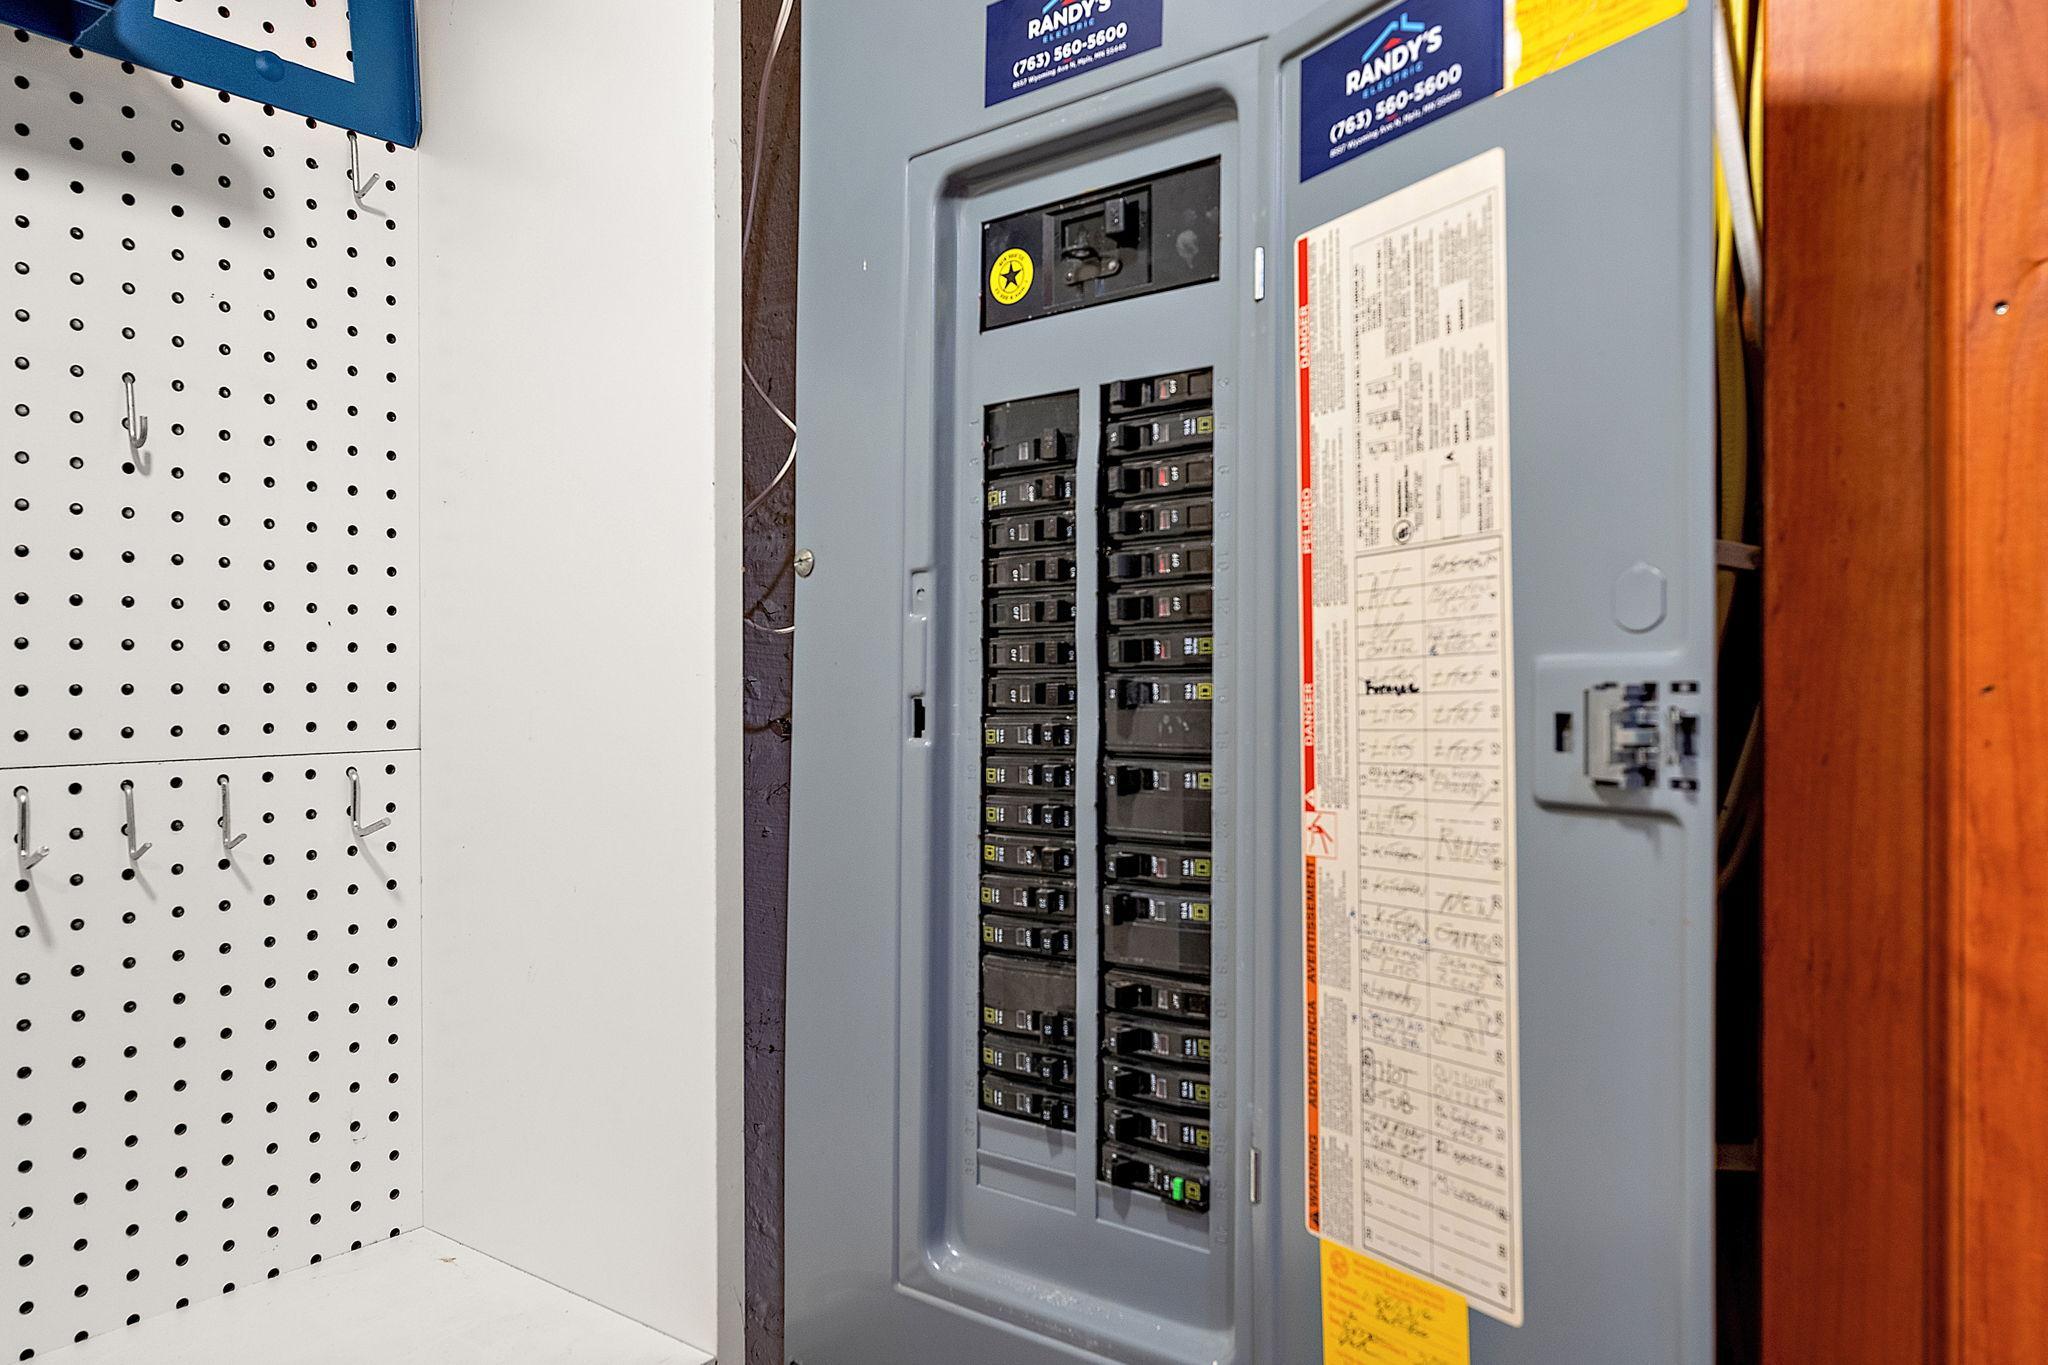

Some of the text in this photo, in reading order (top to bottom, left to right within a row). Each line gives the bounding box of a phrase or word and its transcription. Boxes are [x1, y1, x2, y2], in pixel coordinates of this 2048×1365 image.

[1012, 22, 1128, 78] (763) 560-5600
[1042, 17, 1095, 43] ELECTRIC
[1345, 25, 1443, 96] RANDY'S
[1028, 67, 1056, 84] Wyoming
[1057, 65, 1069, 74] Ave
[1329, 63, 1463, 145] (763) 560-5600
[1362, 60, 1424, 100] ELECTRIC
[1346, 128, 1379, 150] Wyoming
[1299, 306, 1311, 368] DANGER
[1301, 487, 1313, 554] PELIGRO
[1303, 683, 1315, 747] DANGER
[1305, 861, 1316, 984] AVERTISSEMENT
[1308, 1000, 1318, 1108] ADVERTENCIA
[1308, 1135, 1320, 1208] WARNING
